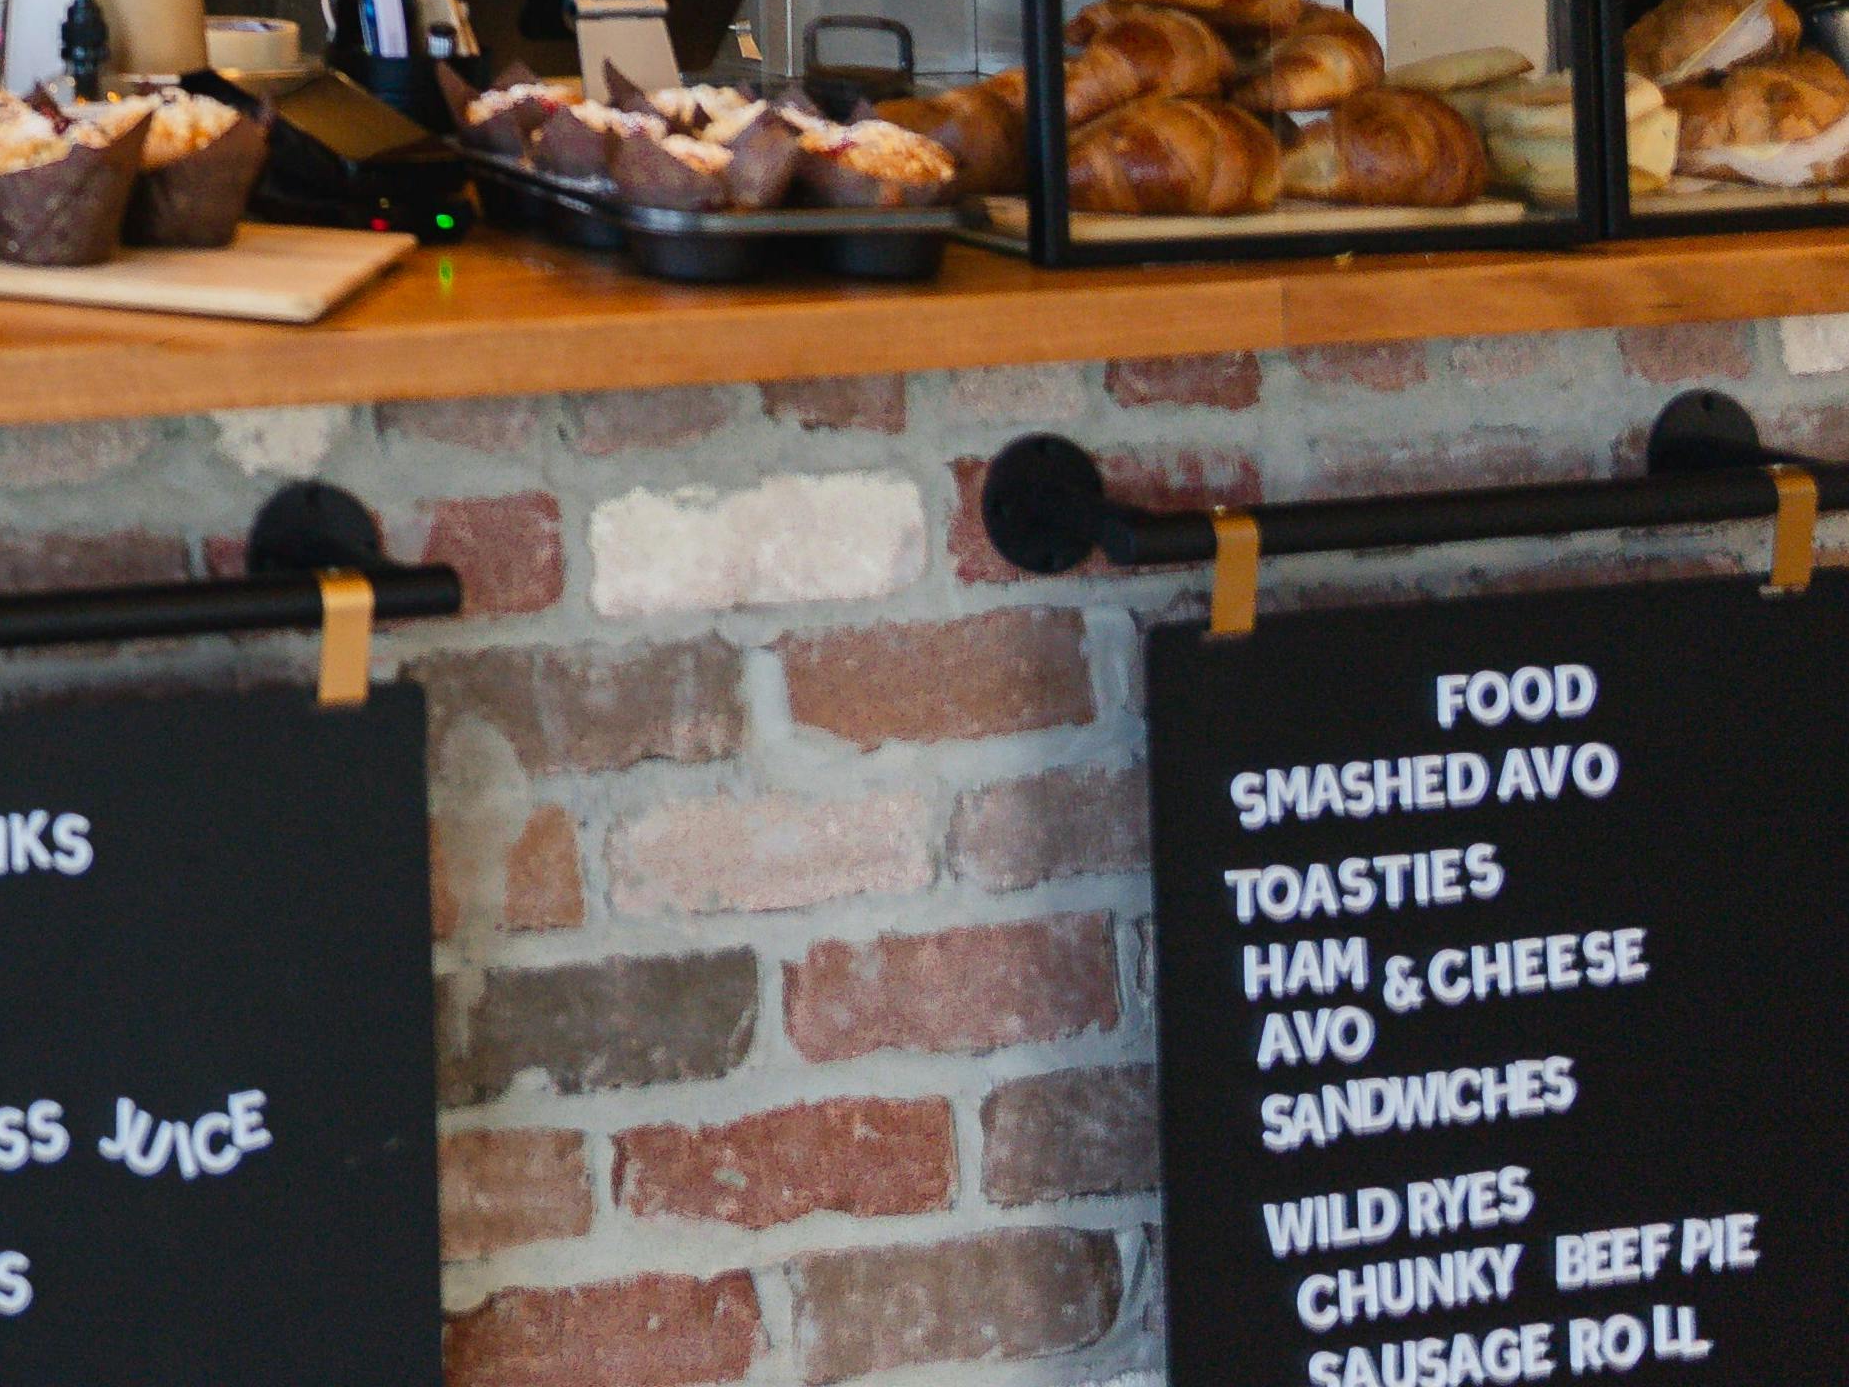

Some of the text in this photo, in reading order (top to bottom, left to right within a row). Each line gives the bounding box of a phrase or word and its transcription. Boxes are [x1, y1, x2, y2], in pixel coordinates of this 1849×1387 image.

[1435, 663, 1598, 729] FOOD
[1229, 741, 1620, 830] SMASHED AVO
[1223, 841, 1505, 924] TOASTIES
[1242, 926, 1650, 1013] HAM & CHEESE
[1255, 1004, 1376, 1070] AVO
[97, 1088, 274, 1180] JUICE
[1259, 1054, 1578, 1152] SANDWICHES
[1262, 1164, 1535, 1258] WILD RYES
[1295, 1212, 1761, 1332] CHUNKY BEEF PIE
[1307, 1303, 1714, 1387] SAUSAGE ROLL
